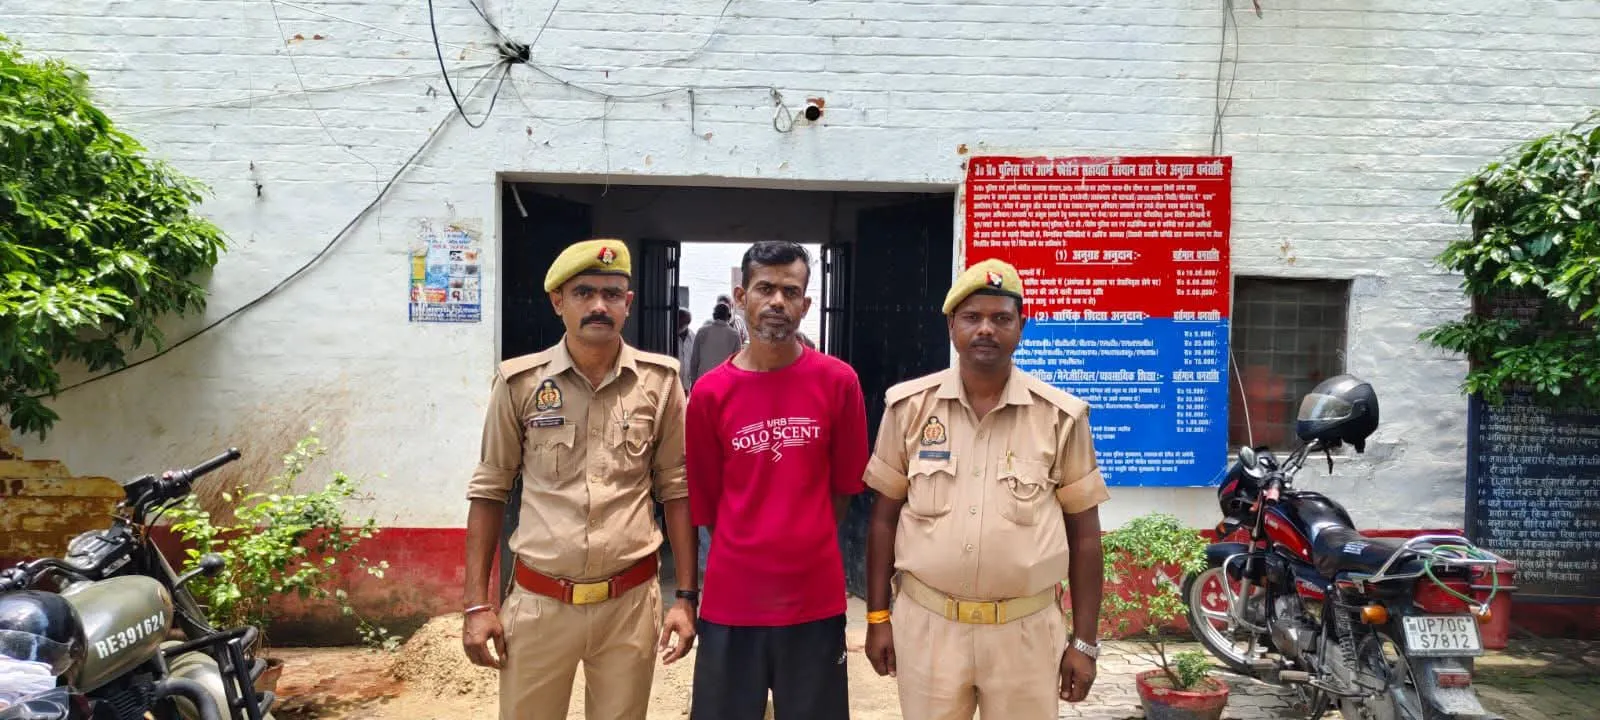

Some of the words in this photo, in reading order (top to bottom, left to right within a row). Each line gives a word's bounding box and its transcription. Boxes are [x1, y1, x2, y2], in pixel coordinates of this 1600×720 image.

[1056, 249, 1067, 261] (1)
[1035, 311, 1049, 323] (2)
[766, 417, 788, 427] MRB
[731, 429, 770, 451] SOLO
[772, 425, 821, 440] SCENT
[1417, 618, 1467, 633] UP70G
[95, 610, 165, 659] RE391624
[1420, 634, 1471, 649] S7812
